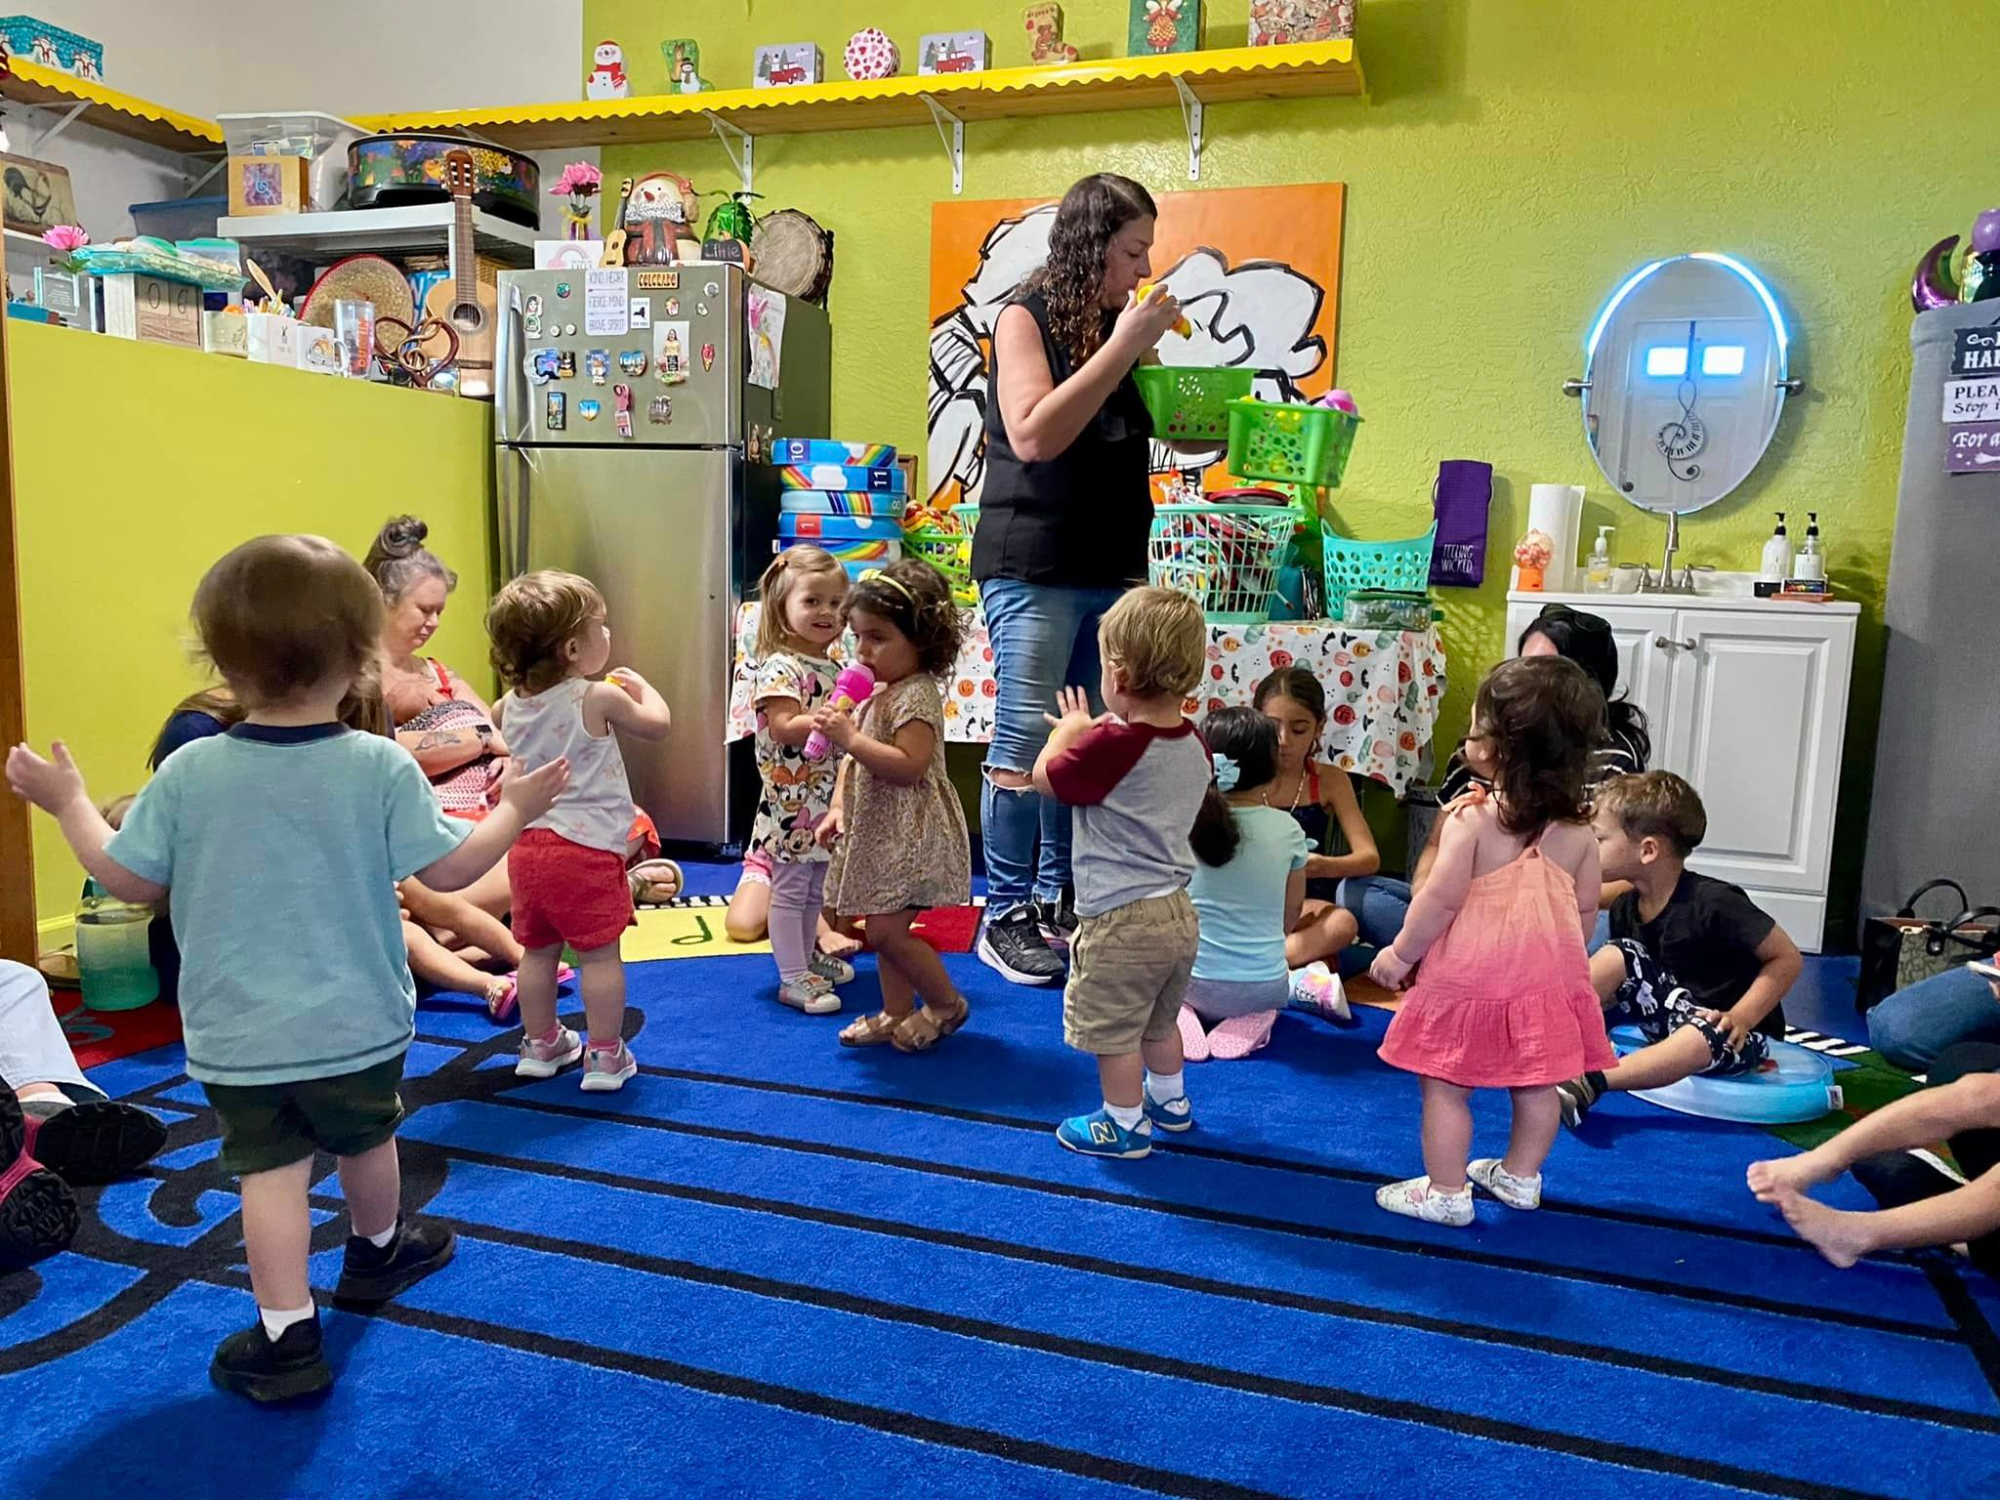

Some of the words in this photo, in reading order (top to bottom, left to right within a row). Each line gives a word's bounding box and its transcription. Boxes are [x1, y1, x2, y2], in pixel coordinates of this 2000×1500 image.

[589, 272, 604, 284] KIND
[605, 271, 625, 284] HEART
[639, 273, 676, 287] COLORADO
[588, 296, 607, 308] FIERCE
[608, 295, 625, 307] MIND
[589, 319, 607, 331] BRAVE
[607, 318, 625, 331] SPIRIT
[1952, 402, 1988, 419] Stop
[1952, 431, 1988, 448] For
[790, 442, 804, 461] 10
[873, 471, 888, 487] 11
[1441, 558, 1473, 574] WICKED
[1089, 1121, 1118, 1146] N
